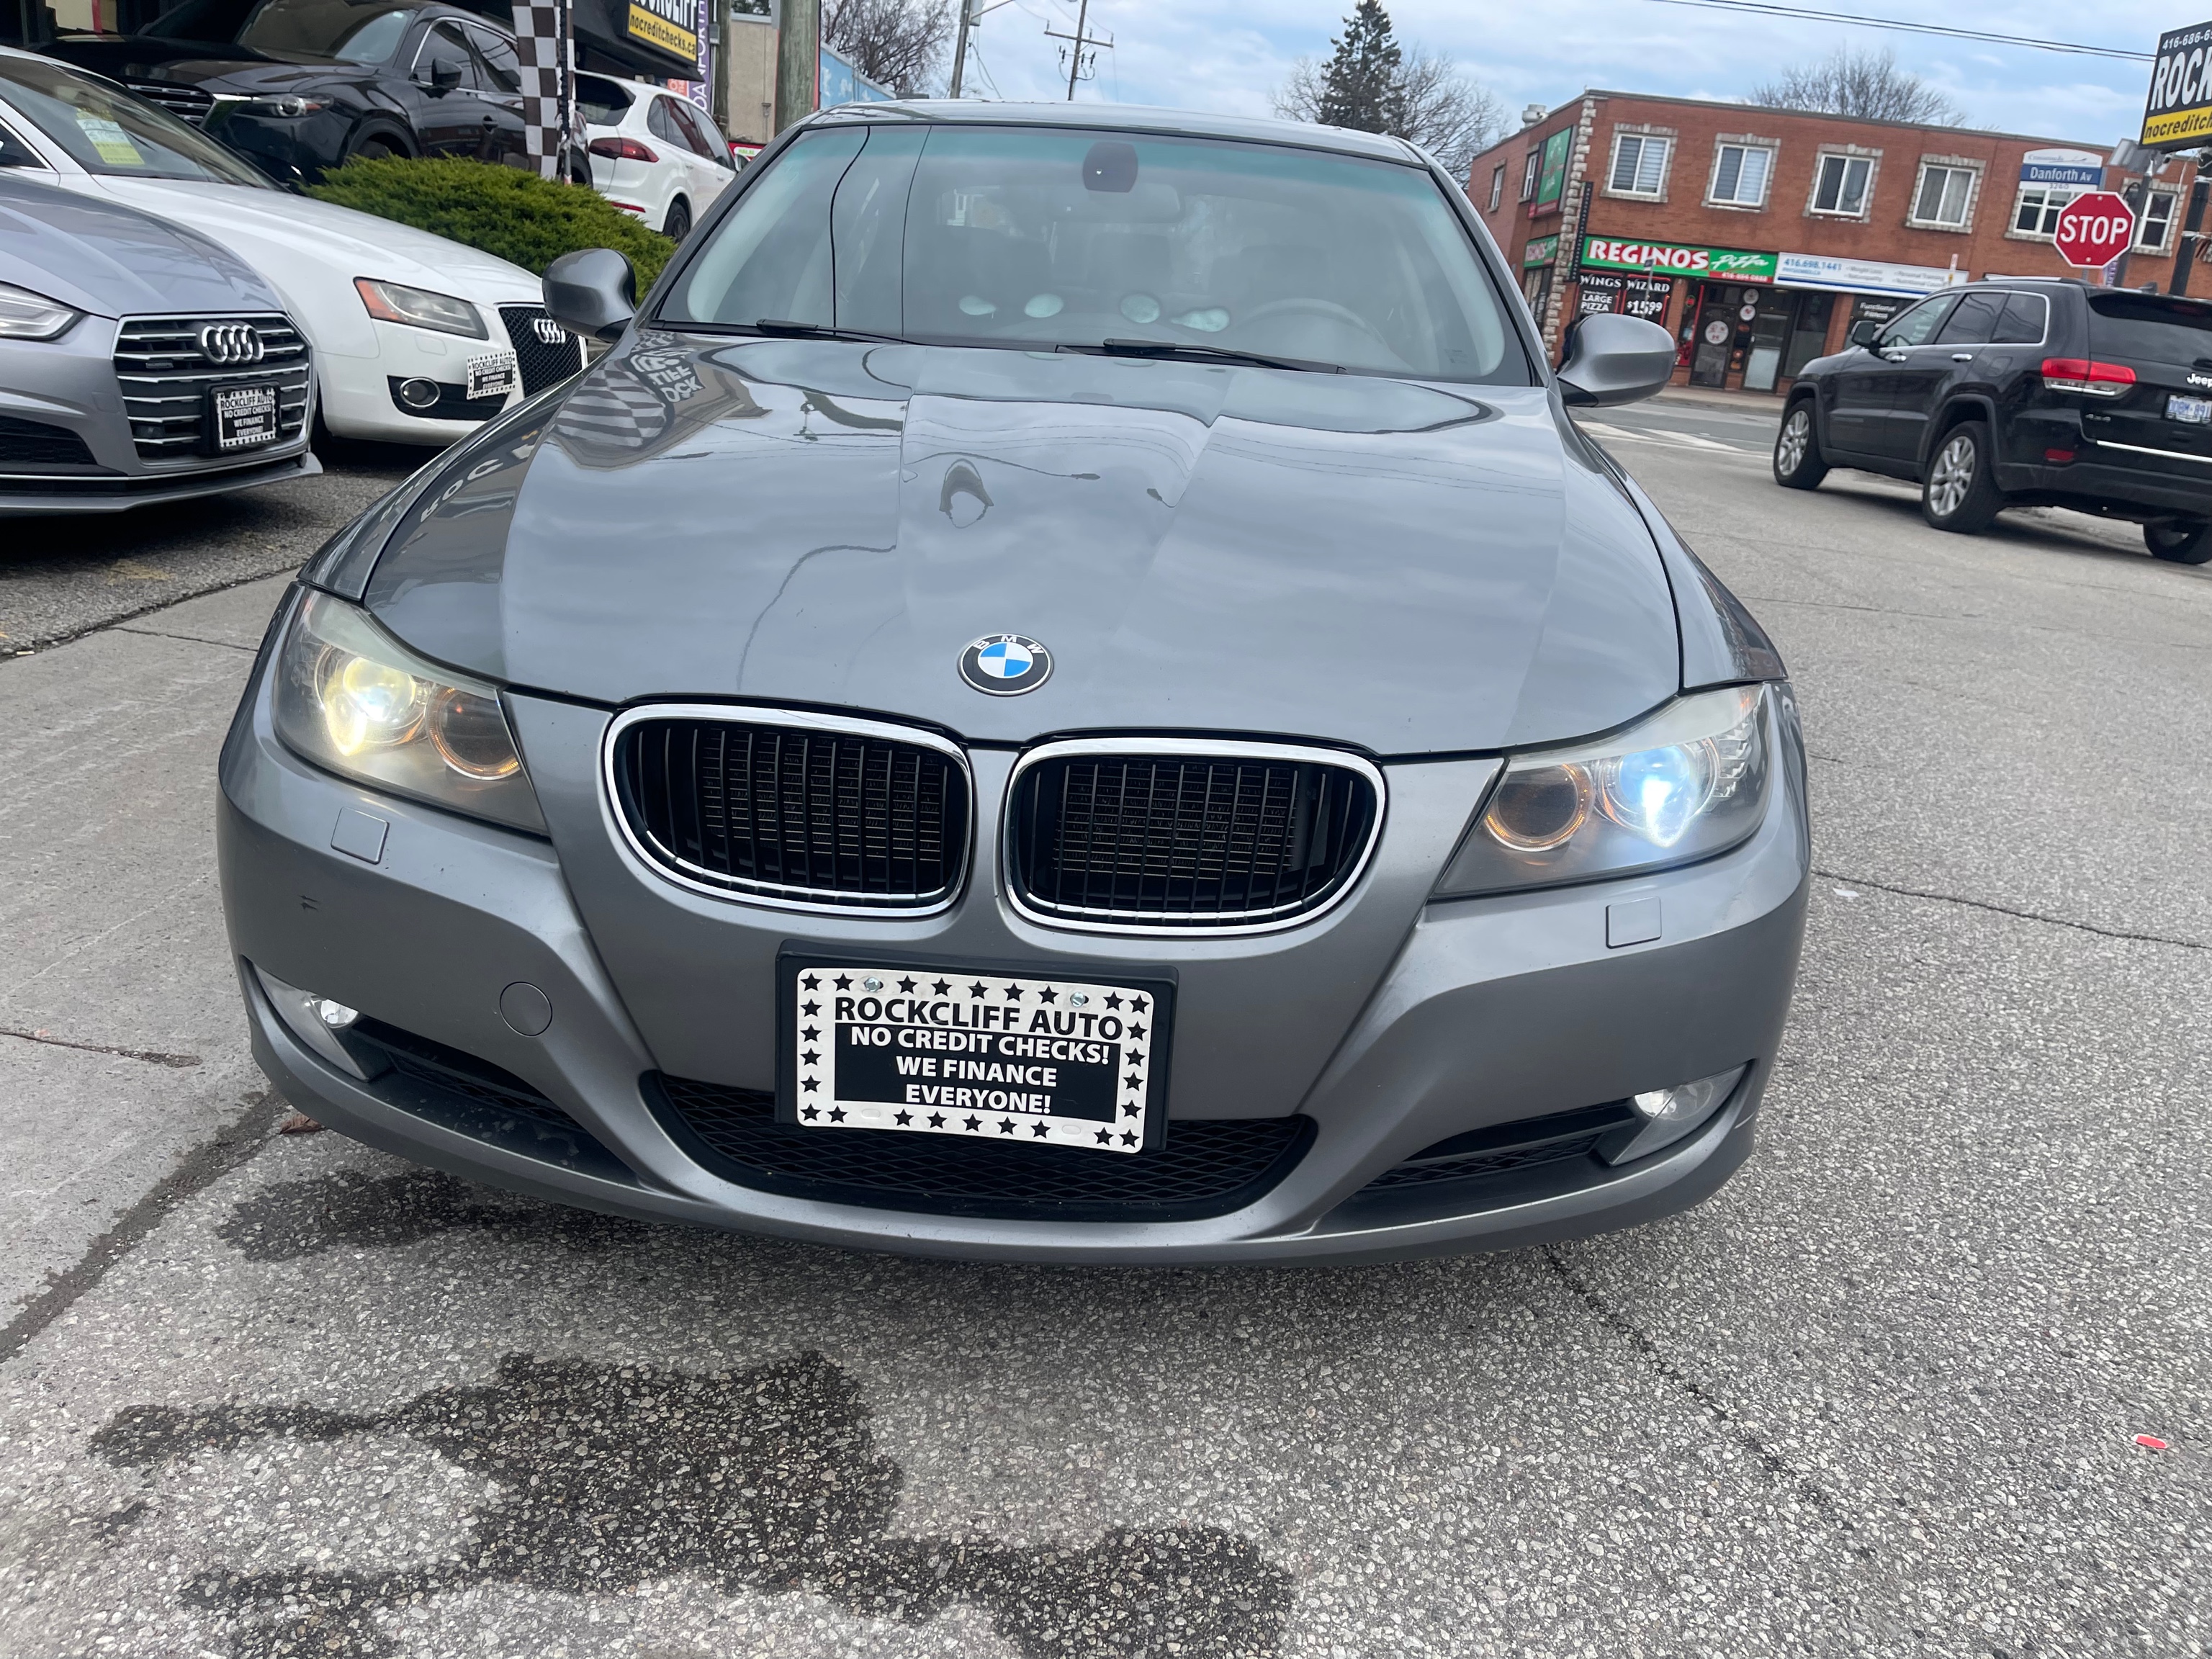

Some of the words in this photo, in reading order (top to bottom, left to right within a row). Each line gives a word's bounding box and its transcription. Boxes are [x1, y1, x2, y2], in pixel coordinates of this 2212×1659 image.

[629, 14, 696, 55] nocreditchecks.ca
[2030, 166, 2079, 181] Danforth
[2080, 171, 2093, 182] Av
[2060, 214, 2128, 245] STOP
[1588, 240, 1709, 269] REGINOS
[1711, 254, 1769, 271] Pizza
[1579, 274, 1622, 288] WINGS
[1627, 279, 1670, 292] WIZARD
[1581, 302, 1609, 312] PIZZA
[1582, 294, 1613, 304] LARGE
[2187, 373, 2212, 388] Jeep
[220, 396, 256, 409] ROCKCLIFF
[257, 394, 273, 403] AUTO
[224, 410, 233, 418] NO
[233, 407, 252, 417] CREDIT
[243, 415, 264, 426] FINANCE
[973, 635, 1045, 654] BMW
[835, 997, 1021, 1030] ROCKCLIFF
[1029, 1010, 1123, 1041] AUTO
[850, 1026, 892, 1047] NO
[897, 1028, 994, 1054] CREDIT
[998, 1036, 1110, 1066] CHECKS!
[896, 1056, 938, 1078] WE
[943, 1059, 1058, 1087] FINANCE
[905, 1084, 1051, 1115] EVERYONE!
